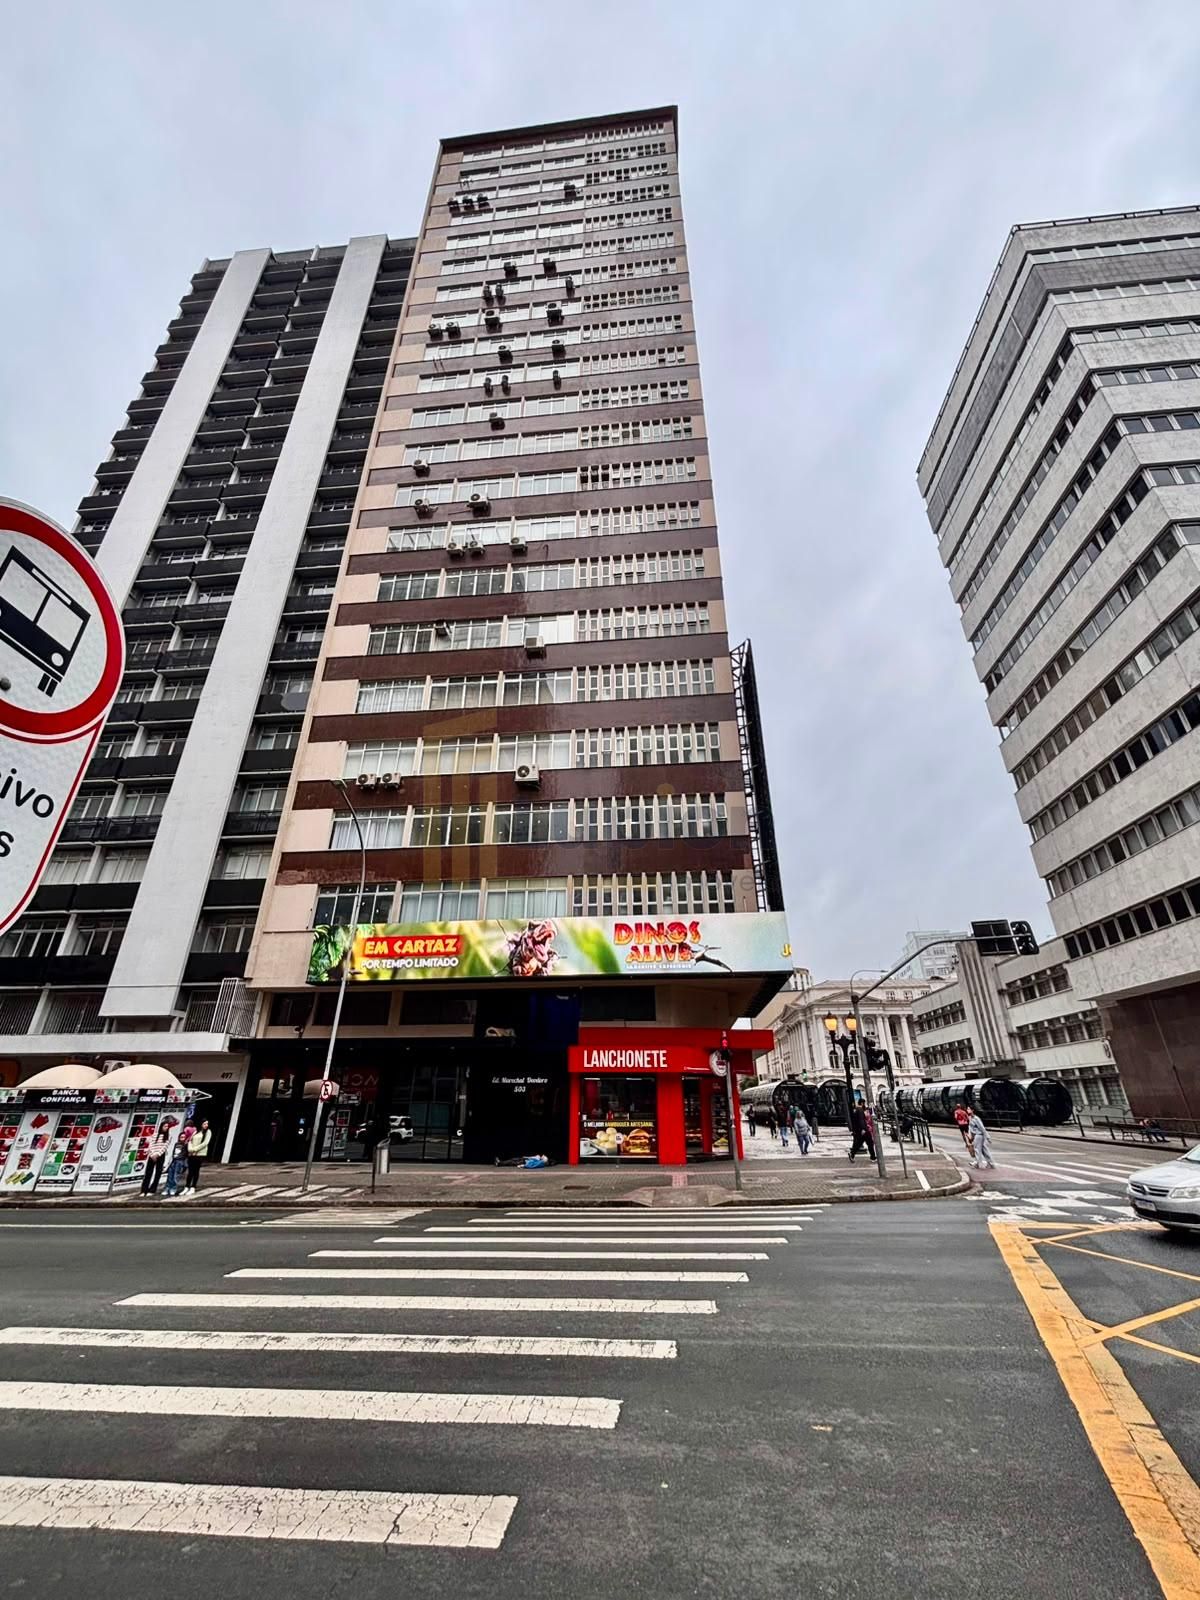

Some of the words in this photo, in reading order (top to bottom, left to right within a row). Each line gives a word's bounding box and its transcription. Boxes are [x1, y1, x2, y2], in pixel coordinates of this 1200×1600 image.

[0, 768, 55, 818] ivo
[0, 830, 15, 857] s
[613, 921, 702, 945] DINOS
[364, 940, 389, 955] EM
[393, 938, 458, 954] CARTAZ
[625, 943, 695, 964] ALIVE
[361, 959, 380, 969] POR
[381, 958, 414, 969] TEMPO
[414, 957, 459, 968] LIMITADO
[583, 1049, 668, 1068] LANCHONETE
[40, 1096, 87, 1104] CONFIANÇA
